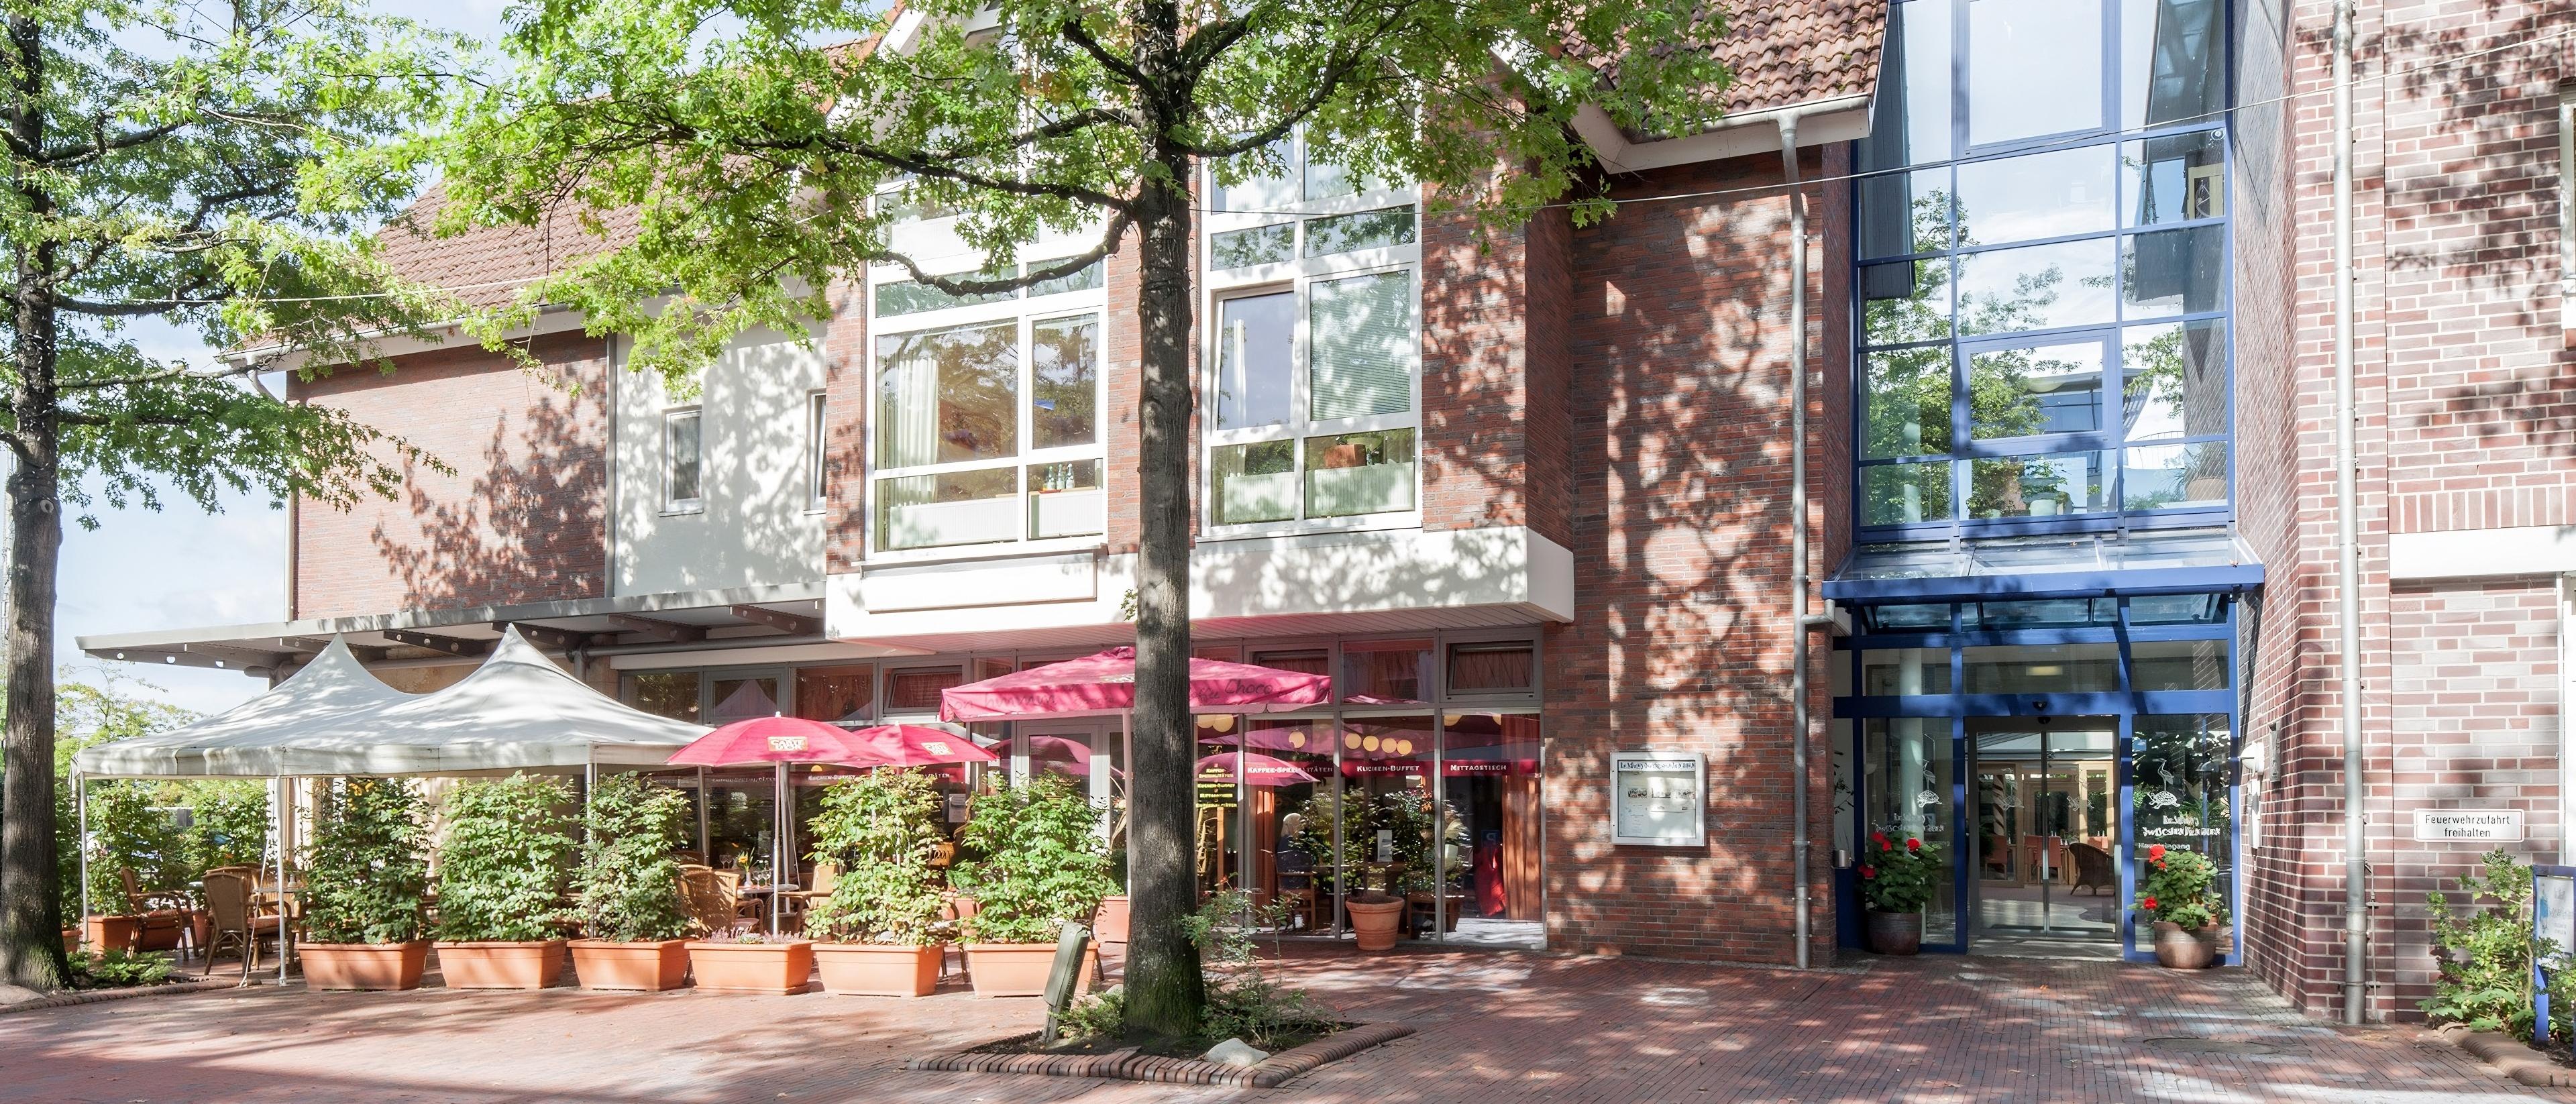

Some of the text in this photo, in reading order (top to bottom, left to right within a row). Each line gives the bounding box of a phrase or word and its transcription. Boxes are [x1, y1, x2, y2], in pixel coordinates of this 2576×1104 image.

[1225, 679, 1273, 694] Choco
[2426, 814, 2510, 824] Feuerwehrzufahrt
[2445, 828, 2490, 837] freihalten
